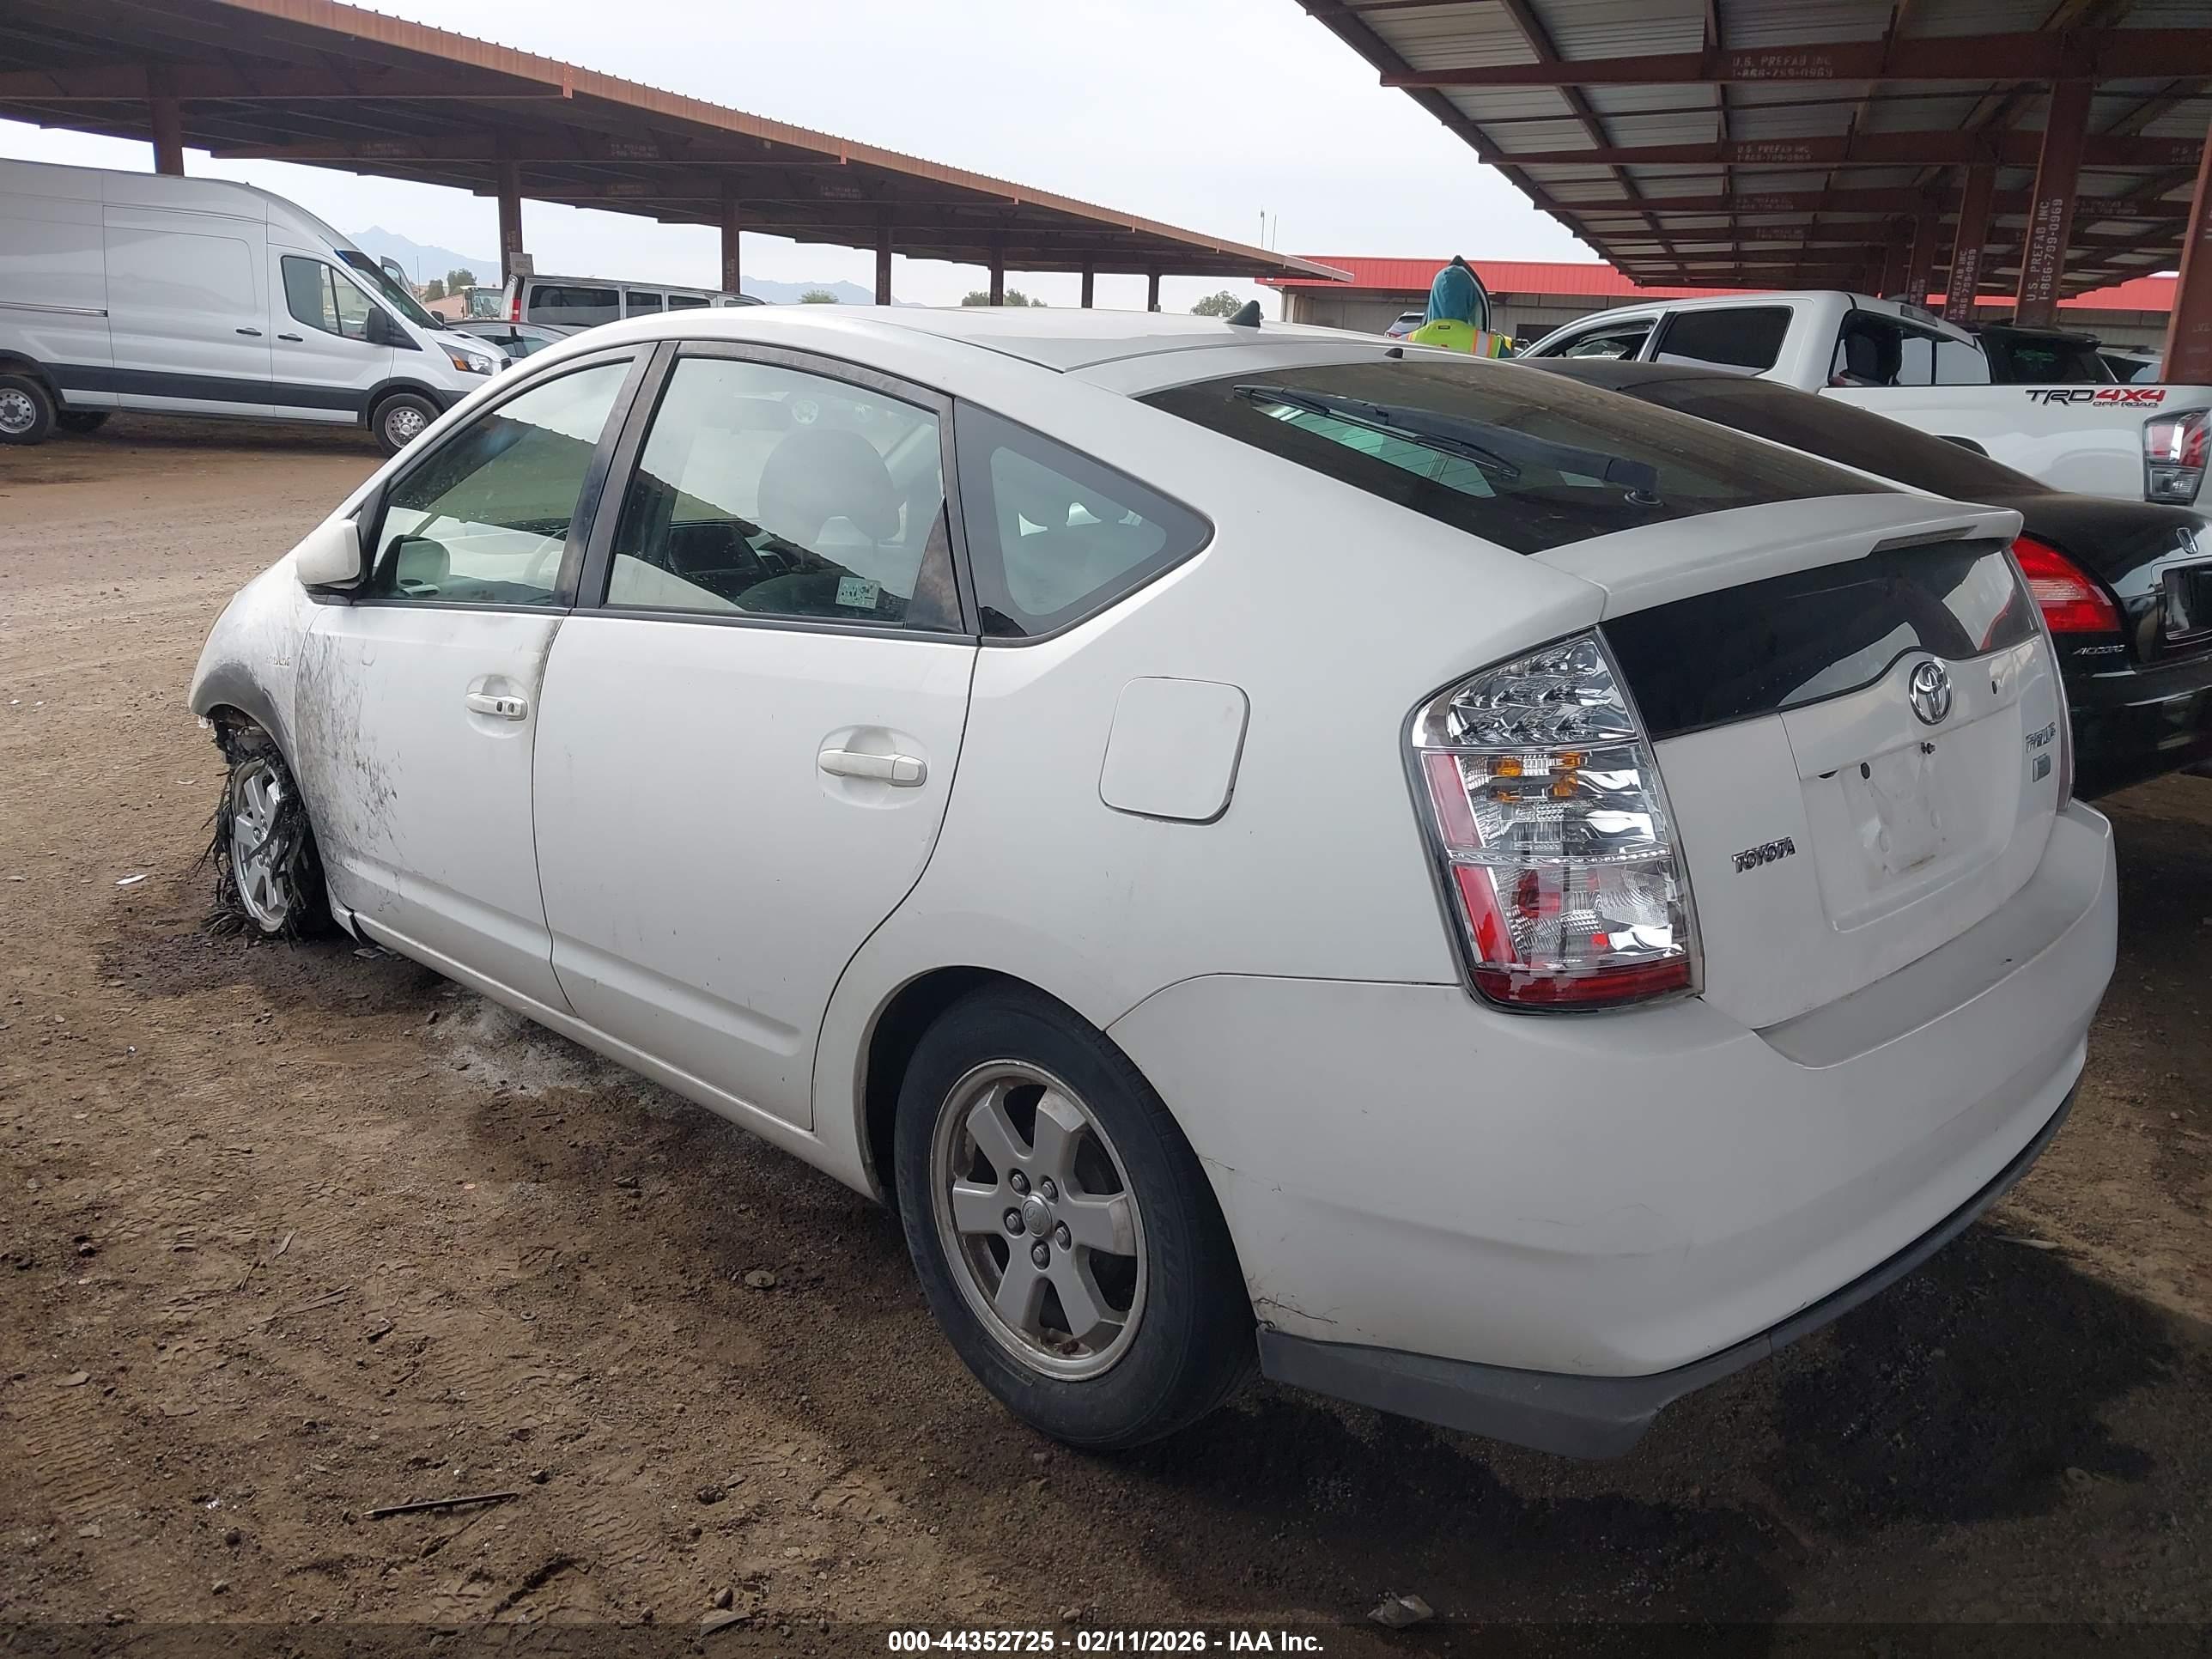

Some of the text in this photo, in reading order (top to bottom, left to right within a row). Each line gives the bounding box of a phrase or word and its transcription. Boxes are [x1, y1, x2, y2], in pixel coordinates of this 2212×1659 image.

[2030, 226, 2046, 273] PREFAB
[2039, 198, 2063, 301] 1-866-799-0969
[2025, 389, 2095, 405] TRD
[1732, 836, 1796, 874] TOYOTA
